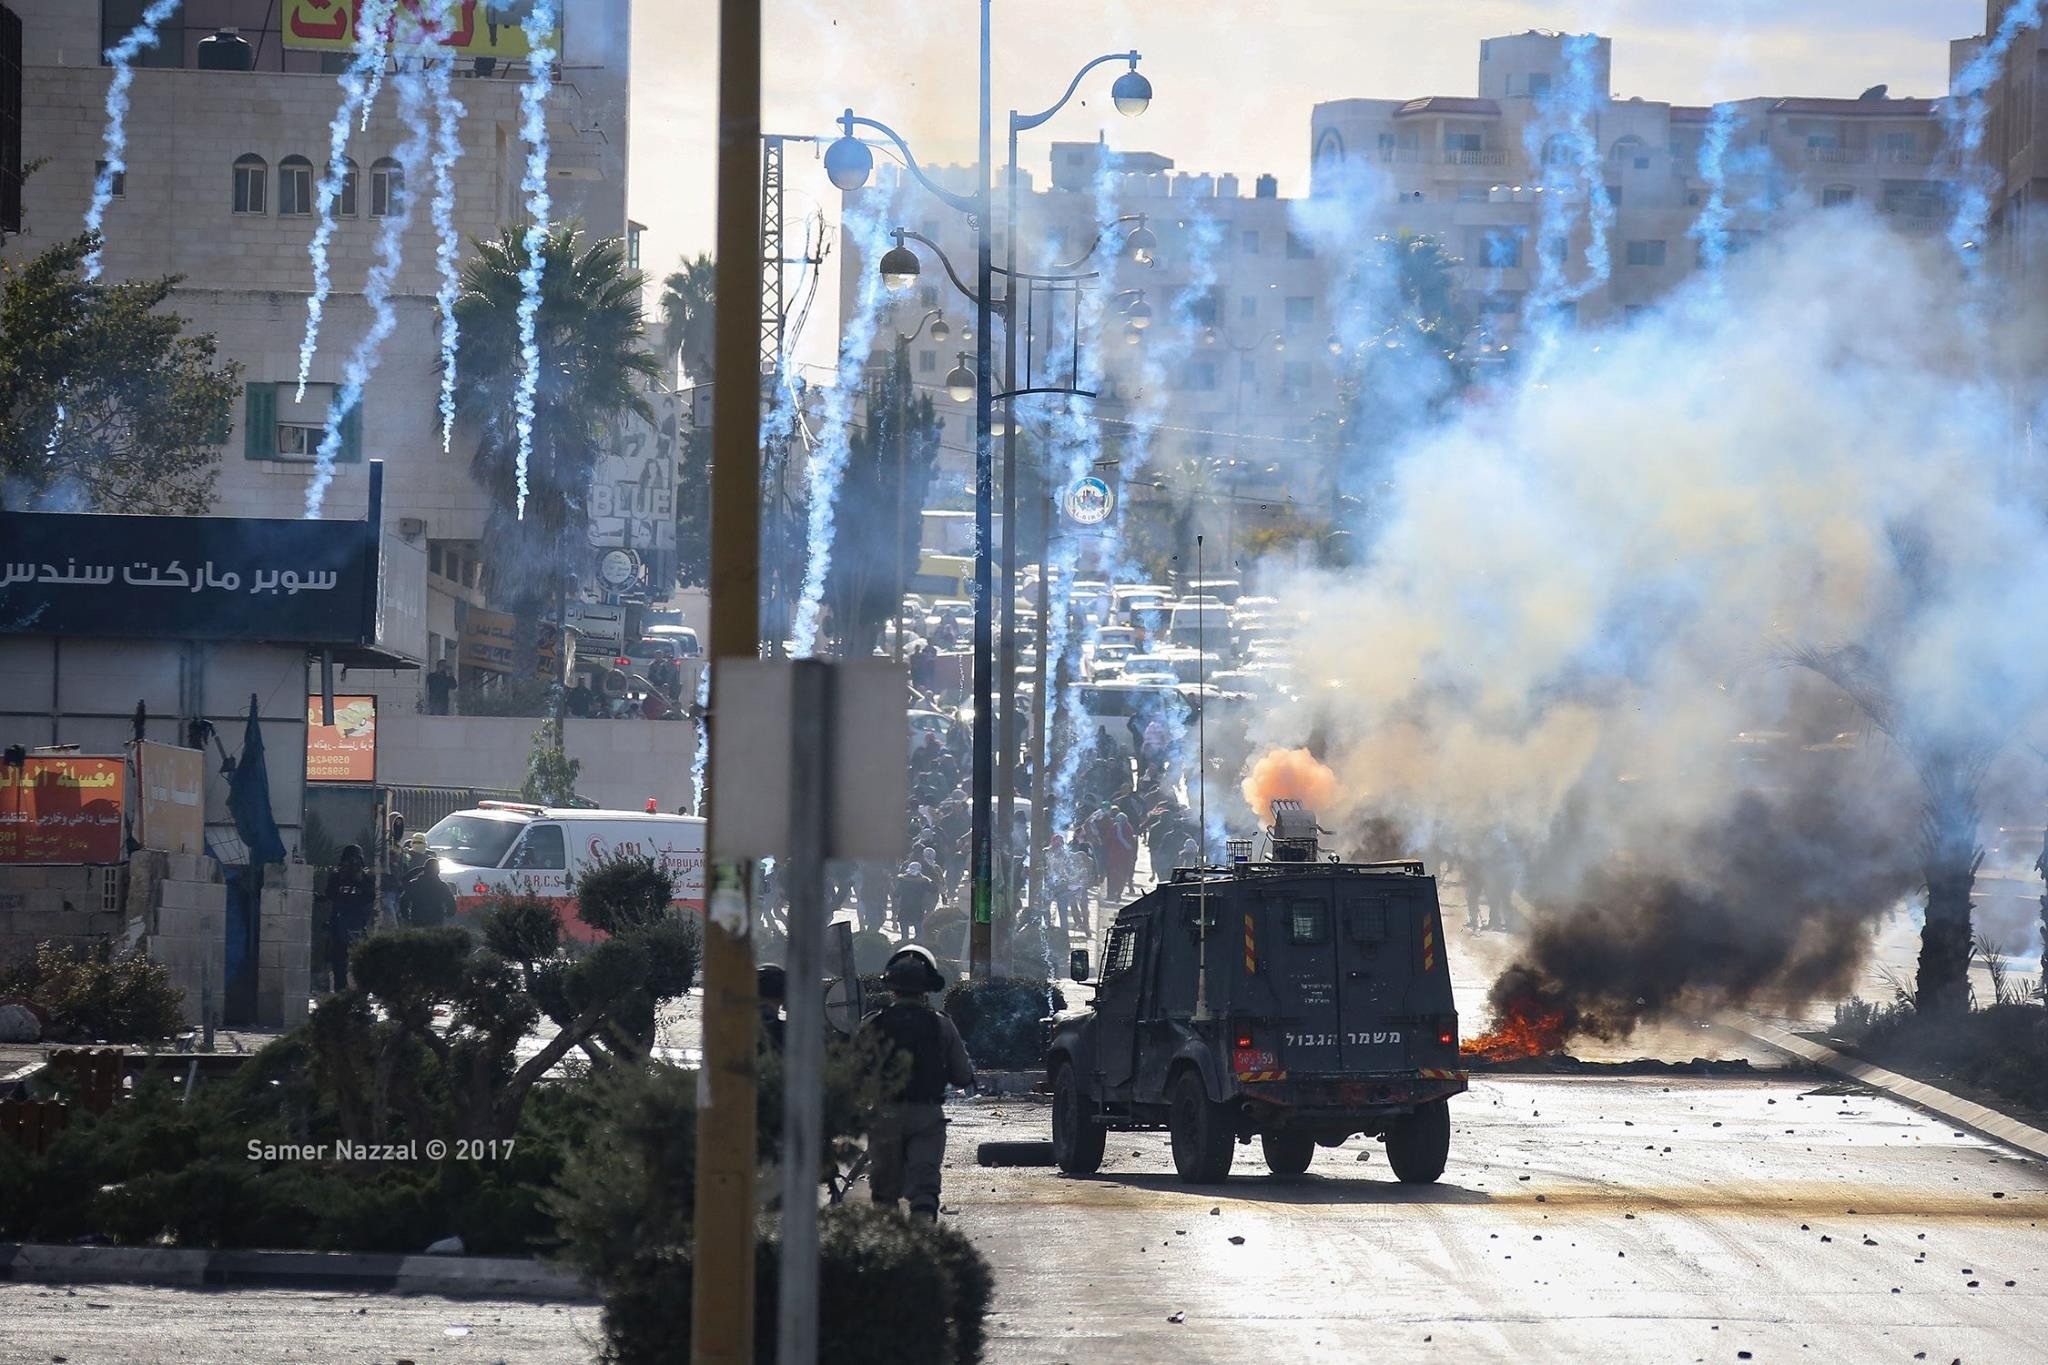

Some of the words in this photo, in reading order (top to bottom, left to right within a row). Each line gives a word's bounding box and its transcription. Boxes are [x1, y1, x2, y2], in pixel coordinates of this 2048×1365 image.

[592, 483, 670, 521] BLUE
[123, 560, 241, 593] ماركت
[250, 569, 337, 595] سوبر
[56, 761, 116, 789] مغسلة
[1285, 1032, 1338, 1047] הגבול
[1347, 1031, 1401, 1045] משמר
